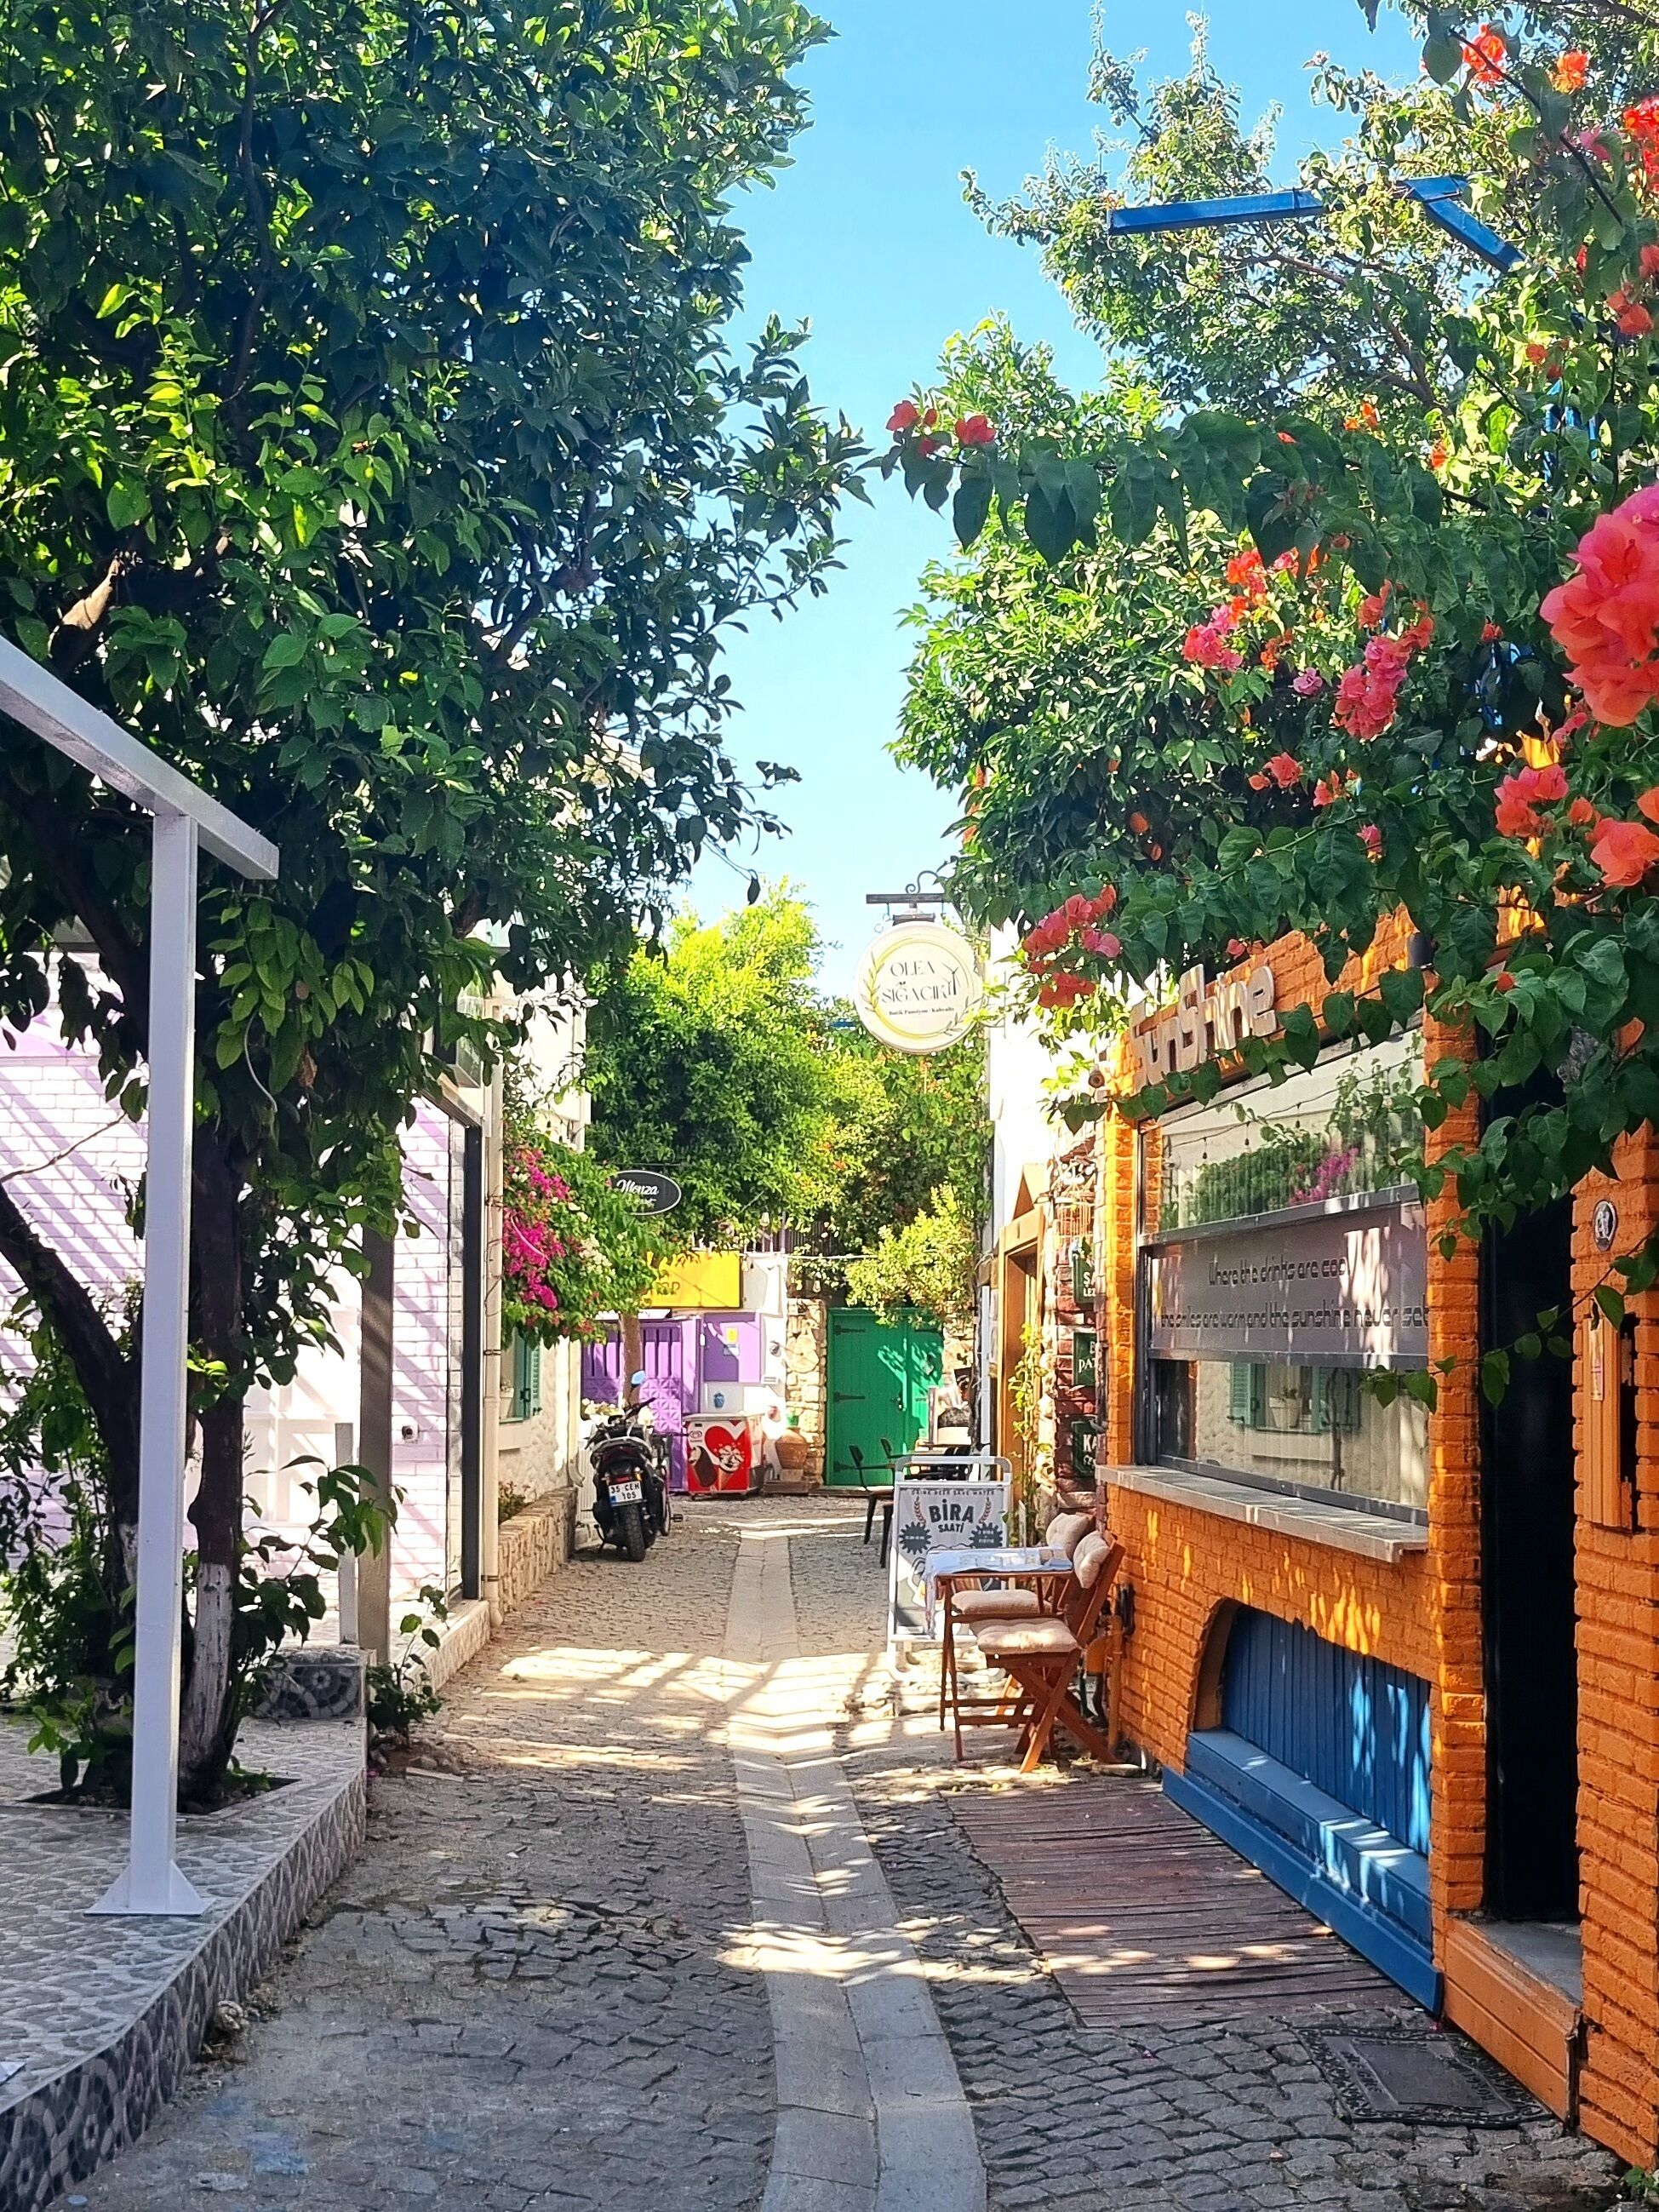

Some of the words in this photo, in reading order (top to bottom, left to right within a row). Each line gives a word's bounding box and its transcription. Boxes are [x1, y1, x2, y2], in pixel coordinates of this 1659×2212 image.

[890, 961, 935, 977] OLEA
[1240, 1259, 1258, 1284] the
[1261, 1255, 1296, 1283] drinks
[1297, 1260, 1319, 1279] are
[1203, 1312, 1219, 1328] are
[1246, 1302, 1267, 1328] and
[1269, 1301, 1290, 1328] the
[1291, 1298, 1352, 1328] sunshine
[1353, 1308, 1399, 1328] never
[929, 1499, 974, 1523] BİRA
